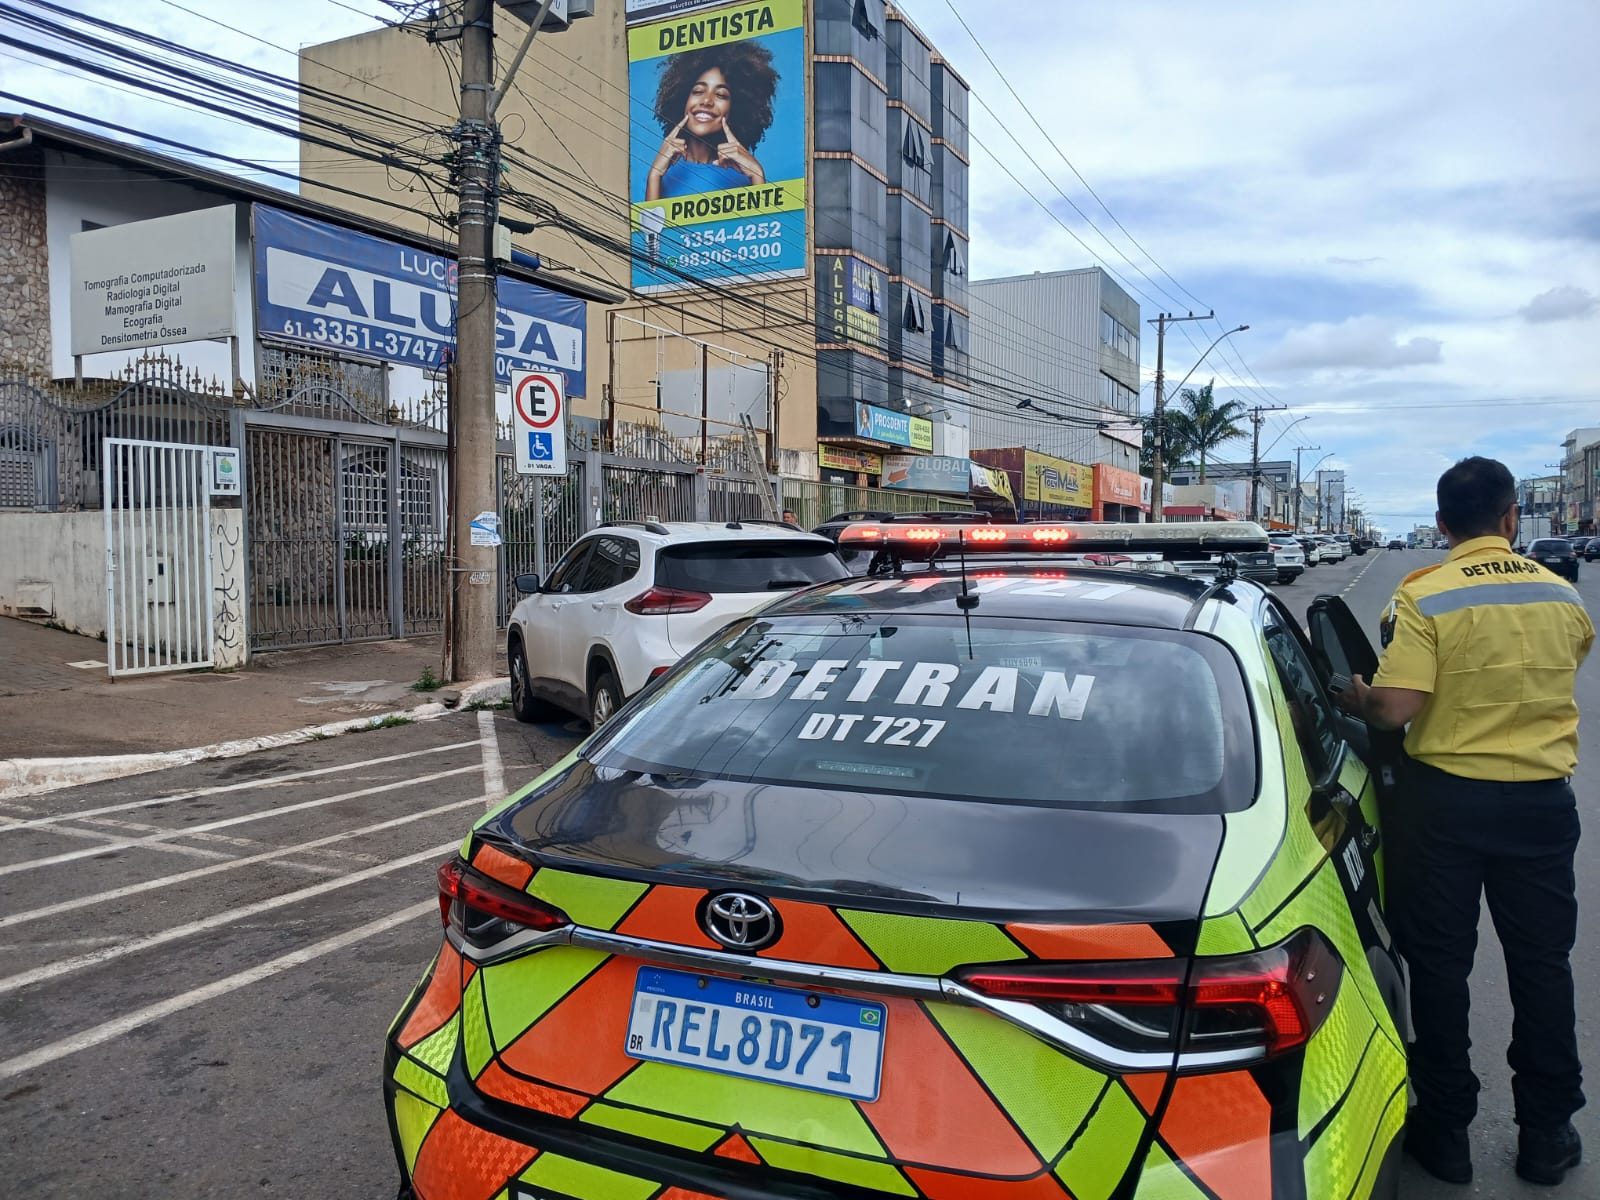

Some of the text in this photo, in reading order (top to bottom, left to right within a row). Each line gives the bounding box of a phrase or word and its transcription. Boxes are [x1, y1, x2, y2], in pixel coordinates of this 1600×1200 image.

[659, 6, 774, 51] DENTISTA
[671, 186, 784, 220] PROSDENTE
[679, 221, 781, 248] 3354-4252
[84, 263, 206, 291] Tomografia Computadorizada
[107, 281, 180, 301] Radiologia Digital
[105, 296, 182, 316] Mamografia Digital
[123, 314, 163, 328] Ecografia
[101, 324, 187, 345] Densitometria Óssea
[529, 385, 547, 417] E
[874, 412, 908, 433] PROSDENTE
[915, 457, 969, 473] GLOBAL
[729, 659, 1096, 721] DETRAN
[797, 712, 946, 748] DT 727
[735, 991, 774, 1009] BRASIL
[629, 1033, 644, 1051] BR
[650, 1000, 853, 1084] REL8D71
